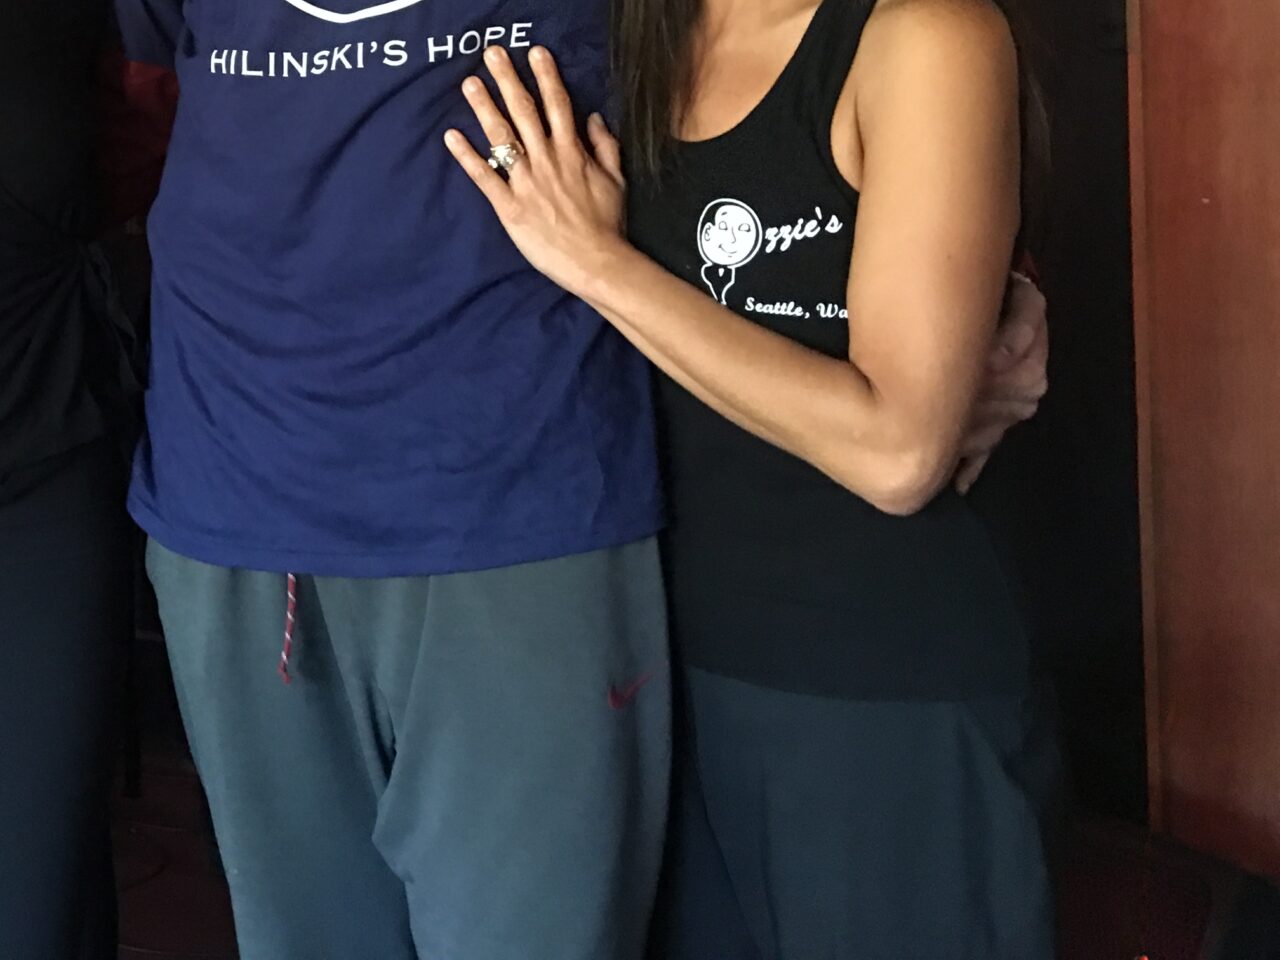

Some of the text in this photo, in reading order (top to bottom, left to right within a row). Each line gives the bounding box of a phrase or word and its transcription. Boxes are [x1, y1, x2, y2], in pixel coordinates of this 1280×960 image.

[210, 22, 533, 77] HILINSKI'S HOPE
[744, 296, 810, 319] Seattle,
